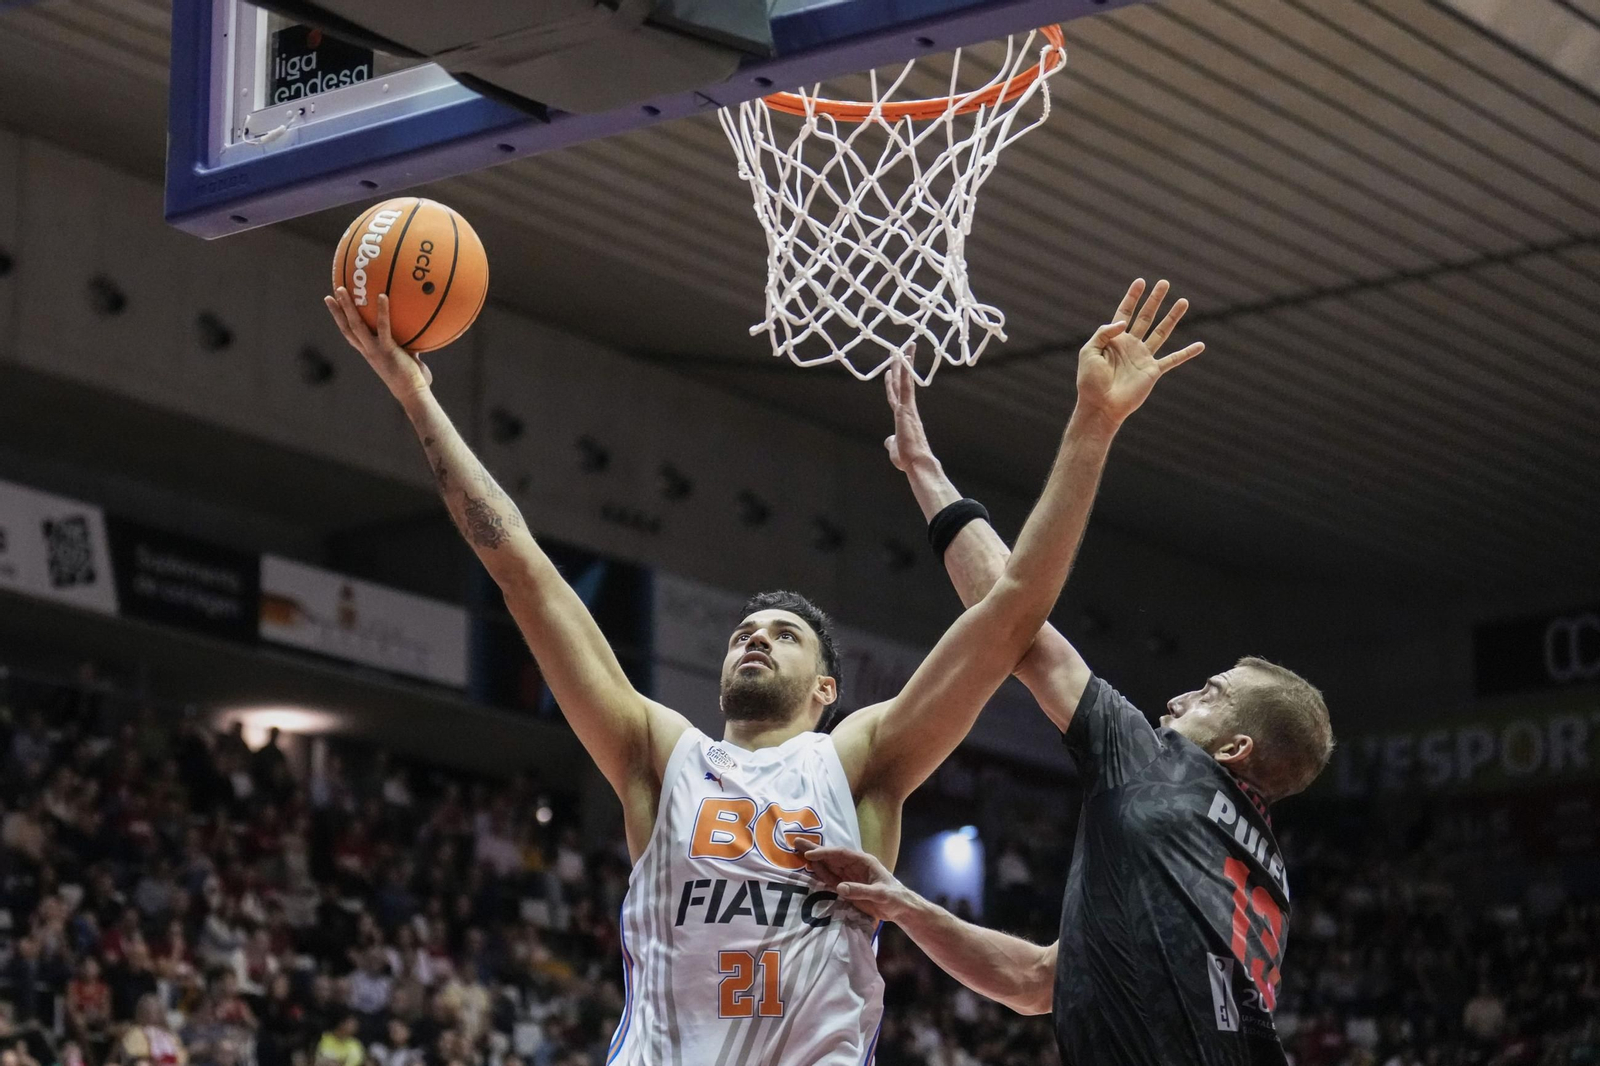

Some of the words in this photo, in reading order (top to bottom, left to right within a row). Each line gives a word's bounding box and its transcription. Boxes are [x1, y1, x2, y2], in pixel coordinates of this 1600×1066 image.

[274, 64, 368, 105] endesa
[275, 51, 316, 82] liga
[353, 209, 404, 307] Wilson
[411, 240, 435, 283] acb
[1335, 712, 1600, 799] L'ESPOR
[688, 797, 824, 872] BG
[674, 878, 839, 929] FIATC
[717, 950, 786, 1020] 21
